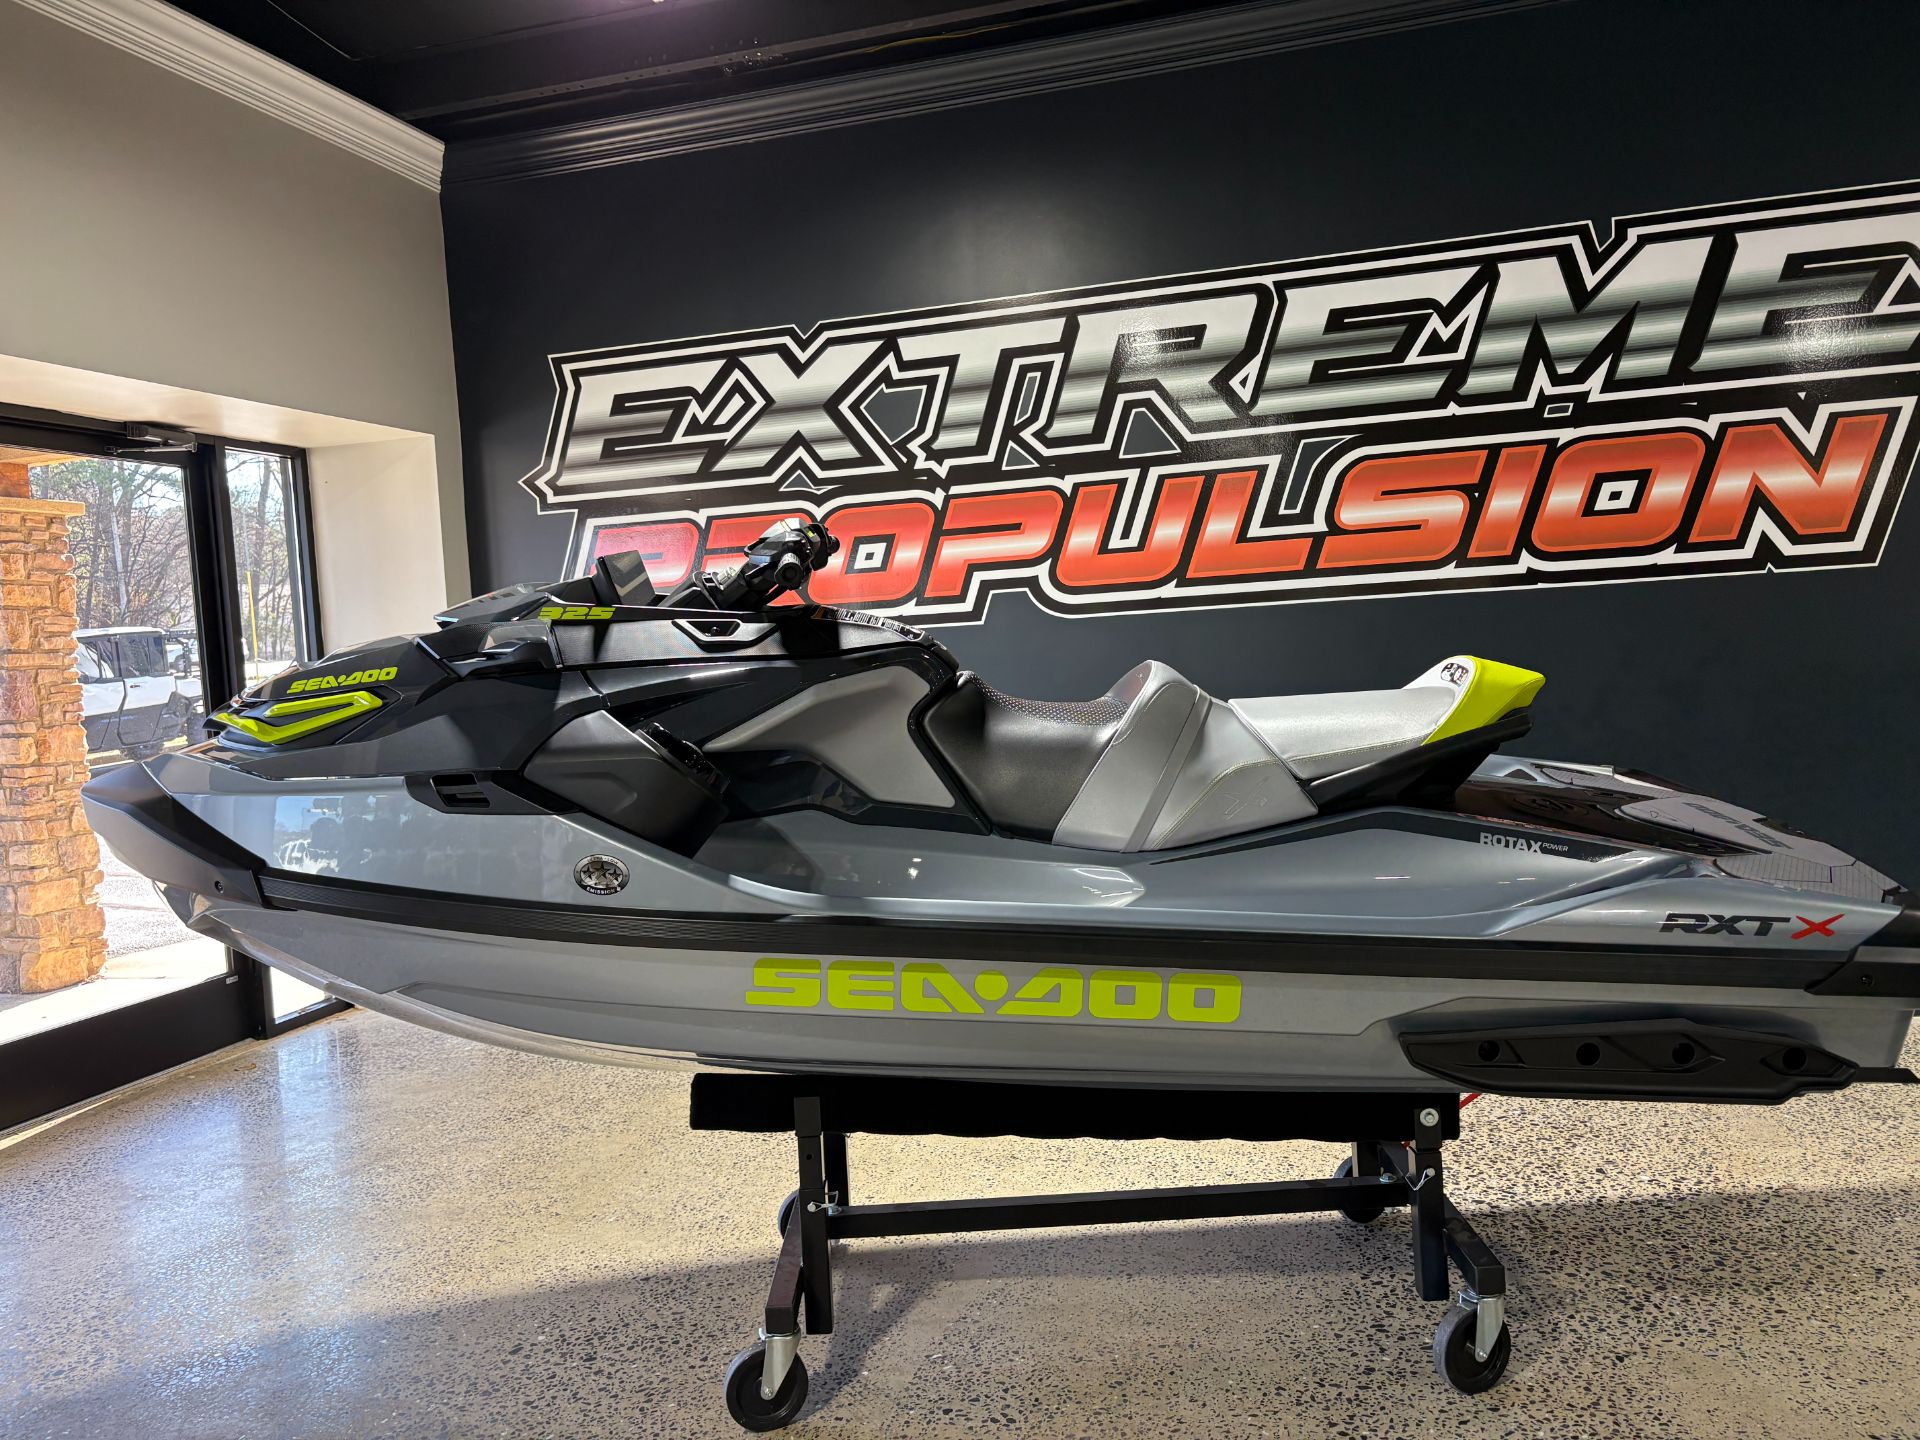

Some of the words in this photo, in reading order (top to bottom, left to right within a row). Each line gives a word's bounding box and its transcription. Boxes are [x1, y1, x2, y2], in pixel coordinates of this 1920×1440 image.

[556, 211, 1920, 487] EXTREME
[537, 606, 617, 621] 325
[1479, 832, 1542, 854] ROTAX
[1542, 842, 1569, 852] POWER
[1659, 912, 1791, 937] RXT
[1790, 912, 1846, 940] X
